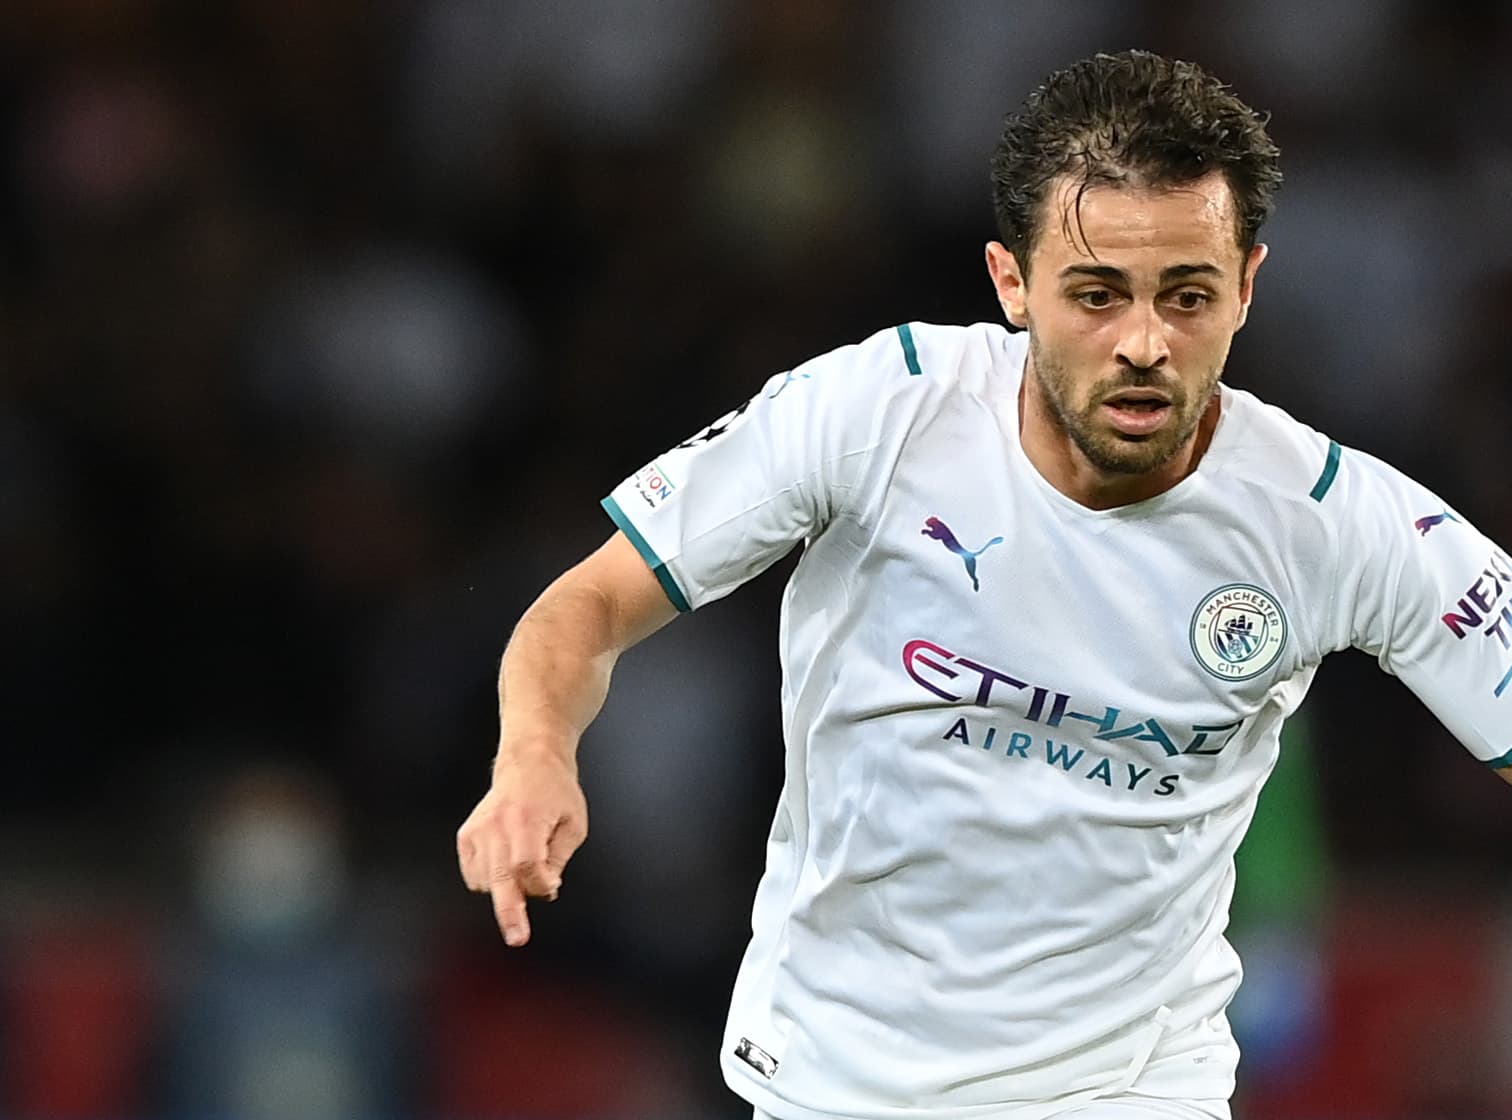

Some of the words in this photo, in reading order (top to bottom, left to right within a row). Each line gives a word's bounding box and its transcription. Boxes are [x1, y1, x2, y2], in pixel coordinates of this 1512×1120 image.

[1206, 591, 1279, 627] MANCHESTER
[1217, 662, 1245, 675] CITY
[903, 639, 1245, 757] ETIHAD
[943, 717, 1179, 796] AIRWAYS
